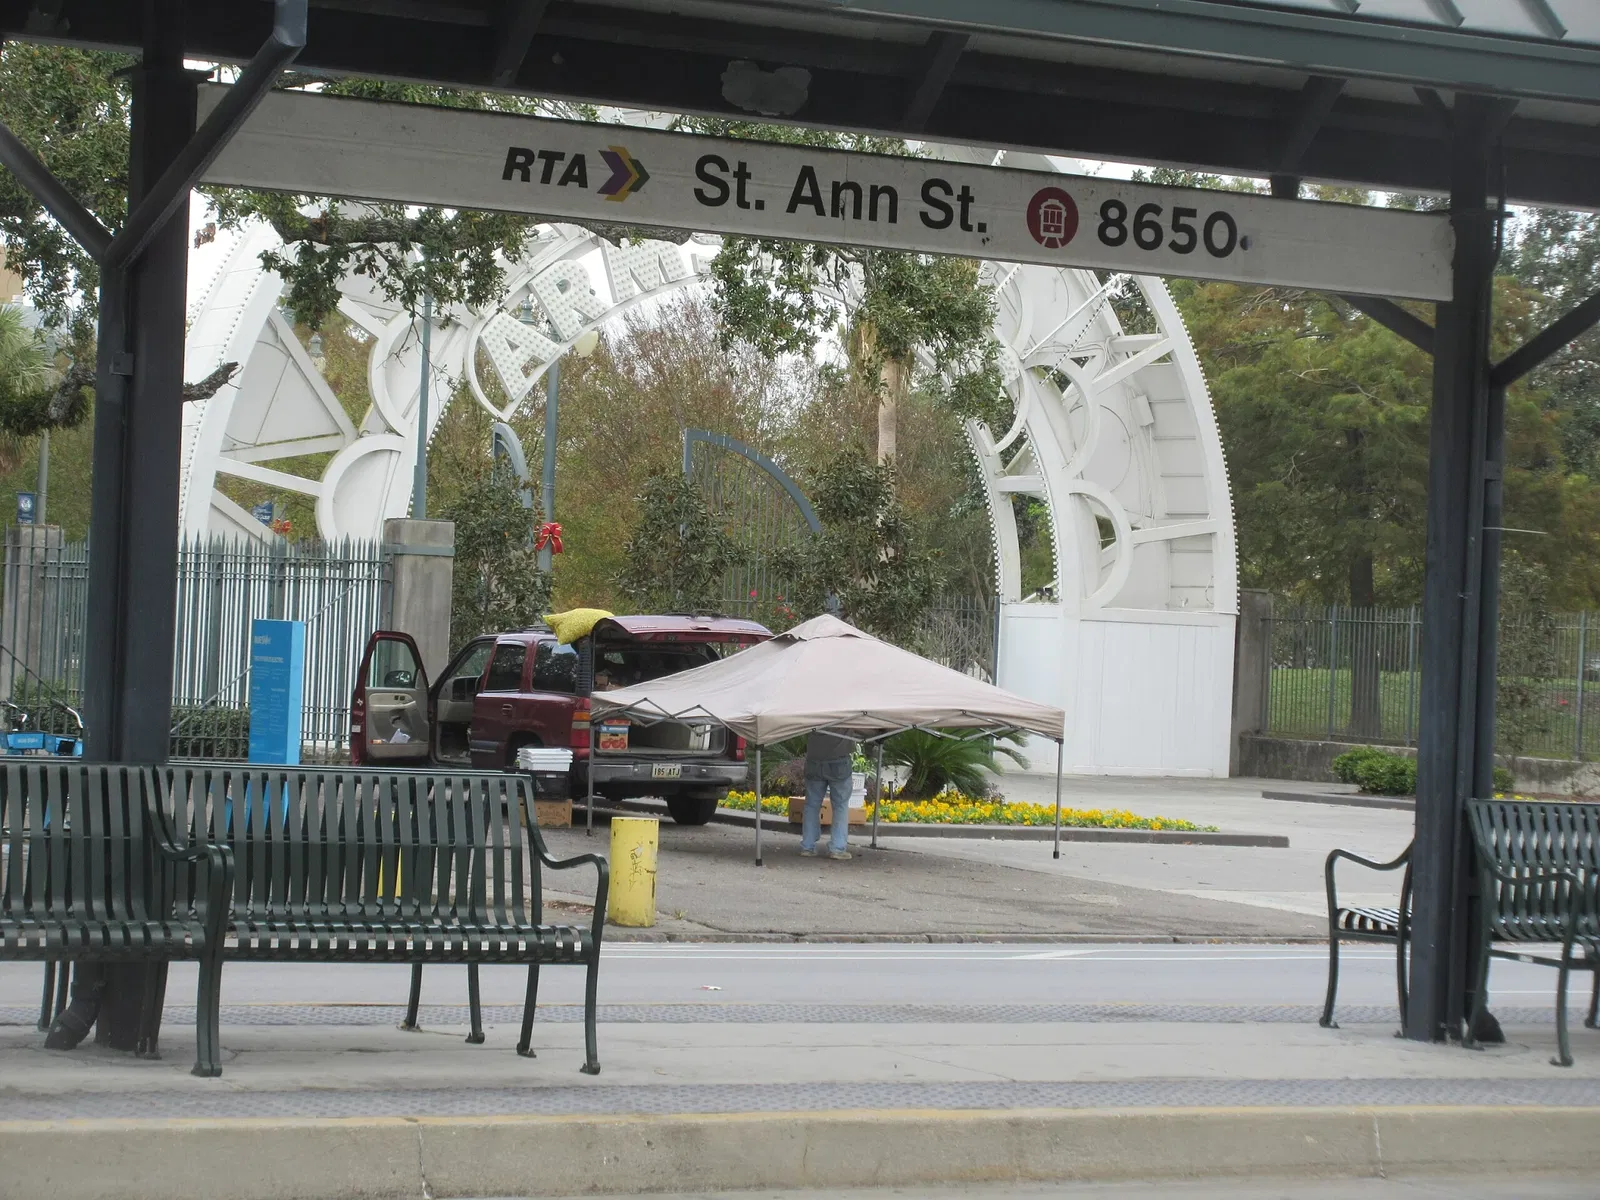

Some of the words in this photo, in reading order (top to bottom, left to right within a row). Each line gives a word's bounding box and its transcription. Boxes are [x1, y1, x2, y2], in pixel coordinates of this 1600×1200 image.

[501, 146, 589, 189] RTA
[693, 154, 765, 211] St.
[785, 164, 899, 224] Ann
[919, 177, 988, 234] St.
[1096, 198, 1238, 258] 8650
